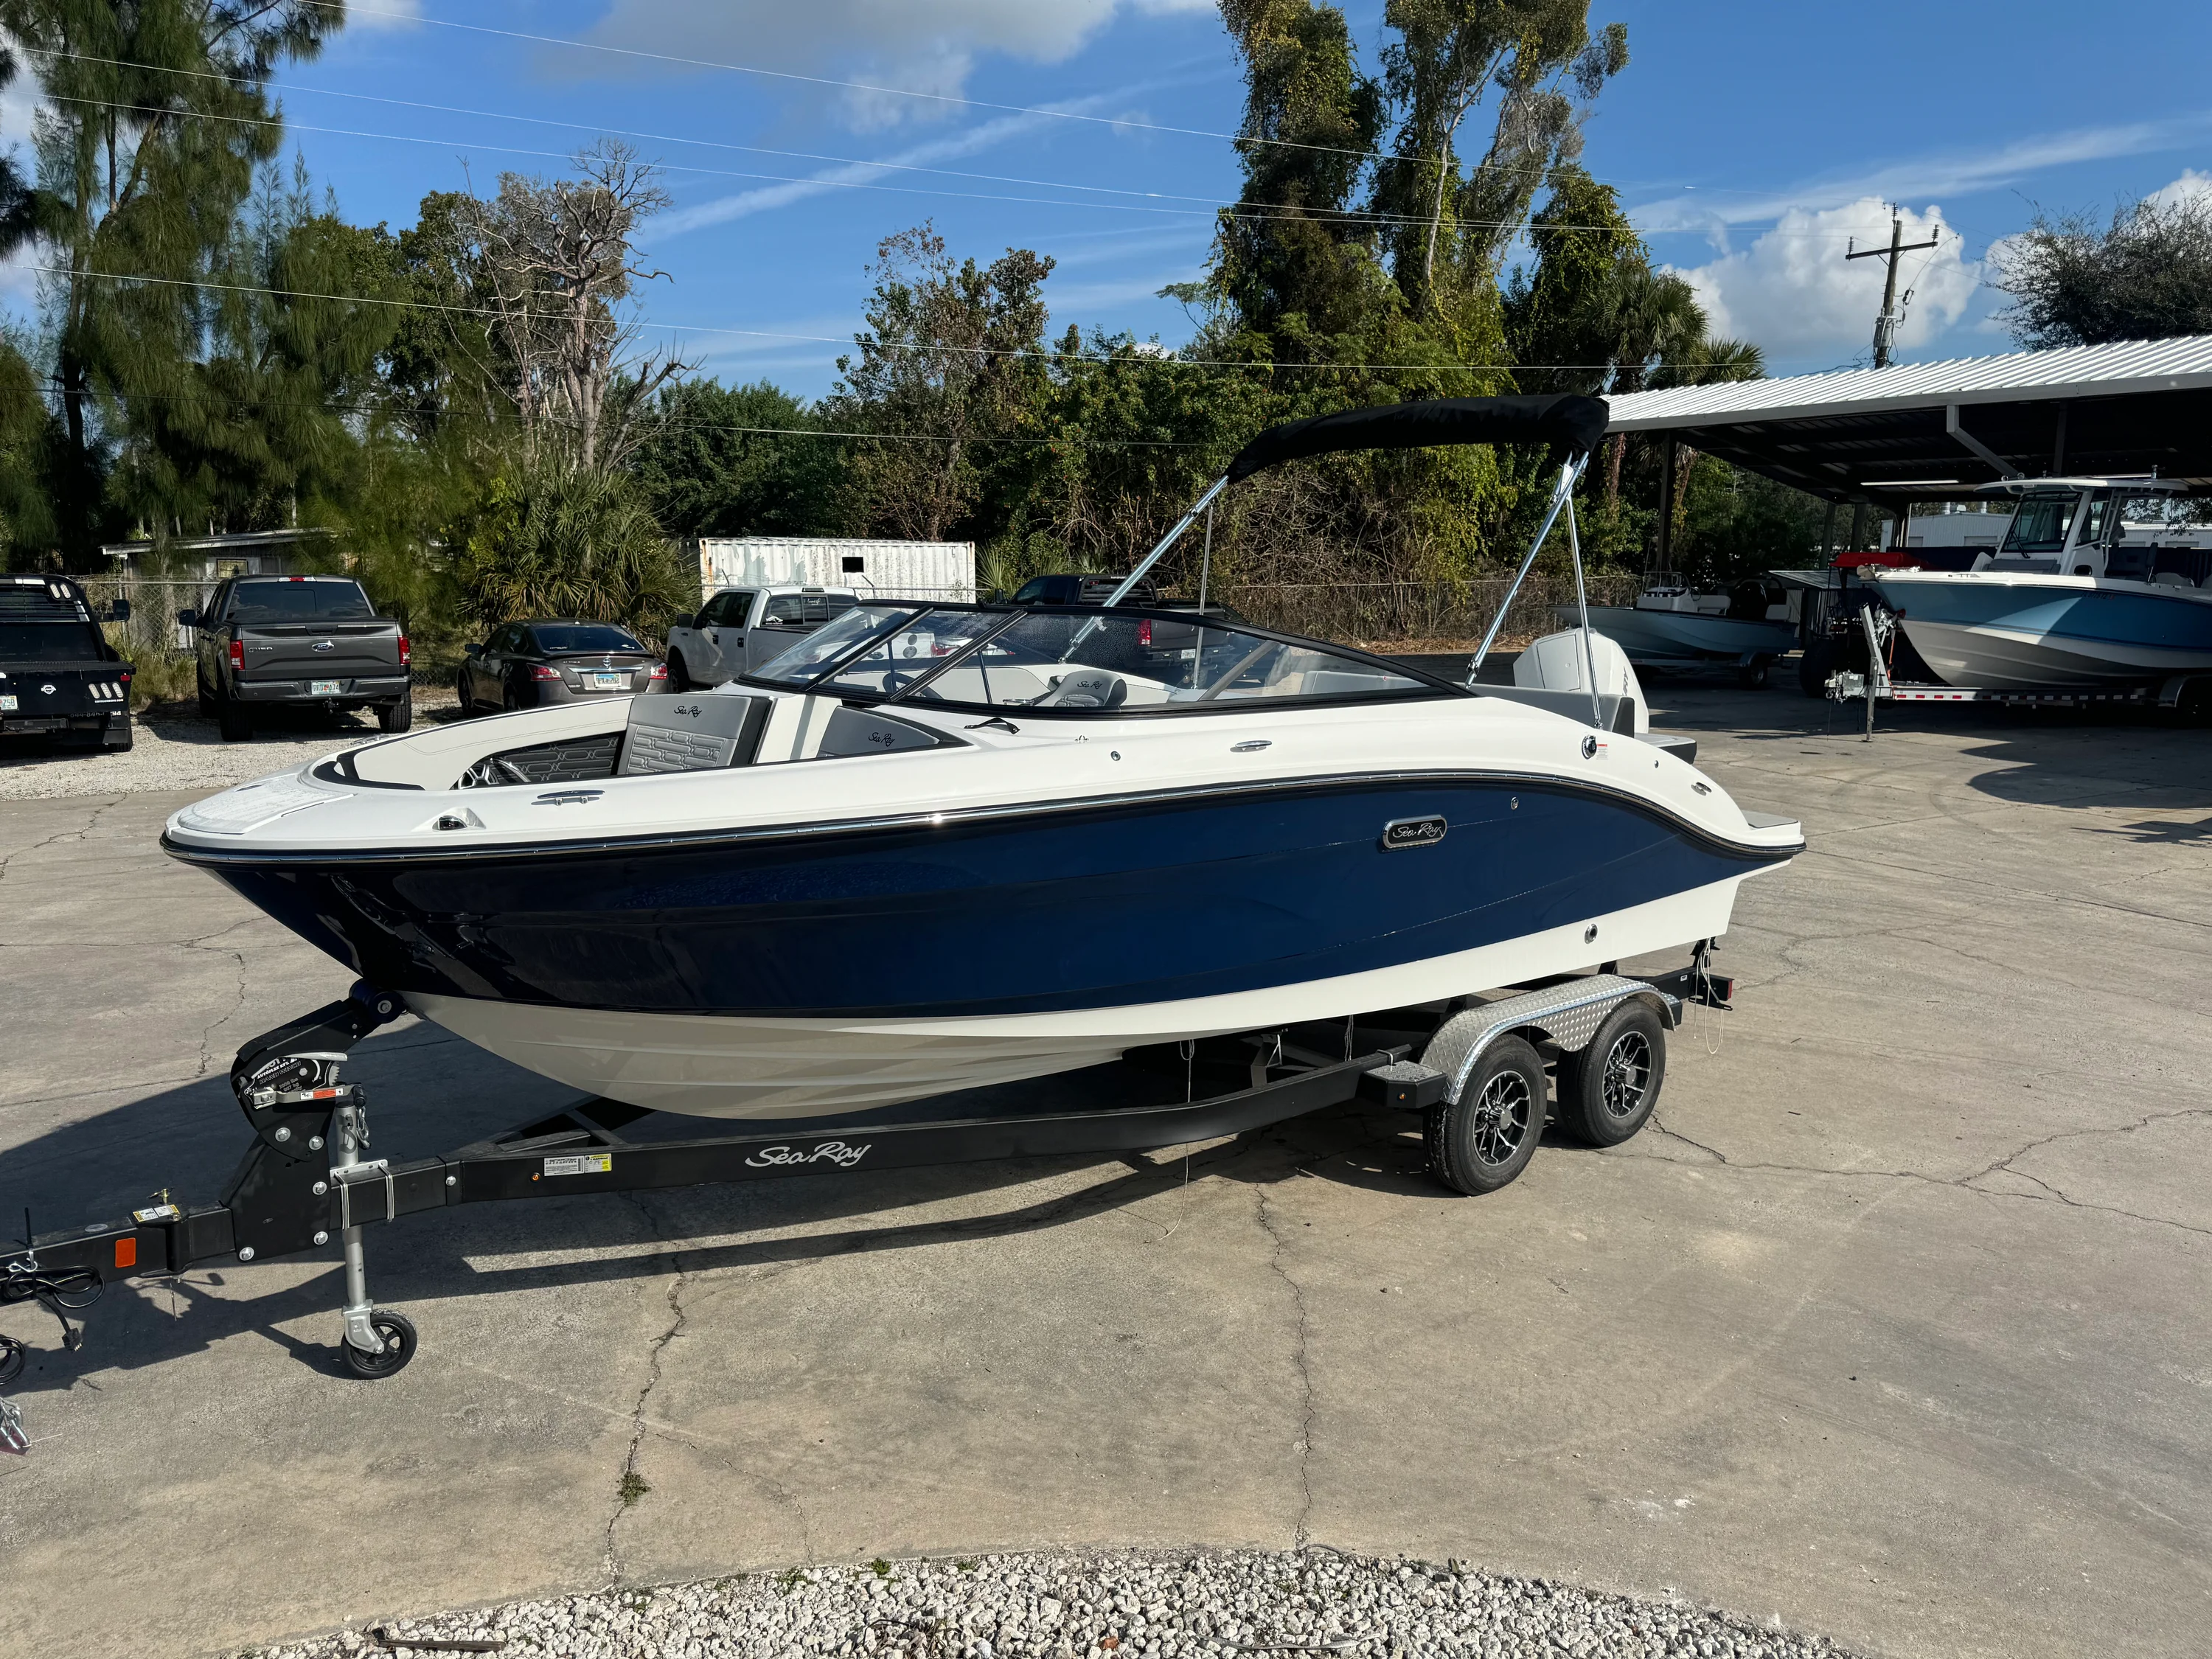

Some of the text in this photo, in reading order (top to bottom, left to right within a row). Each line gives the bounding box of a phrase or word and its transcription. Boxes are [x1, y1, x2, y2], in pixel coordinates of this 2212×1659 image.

[674, 705, 703, 717] Sea Ray
[868, 731, 895, 747] Sea Ray
[1392, 822, 1442, 838] Sea Ray
[745, 1141, 872, 1167] Sea Ray
